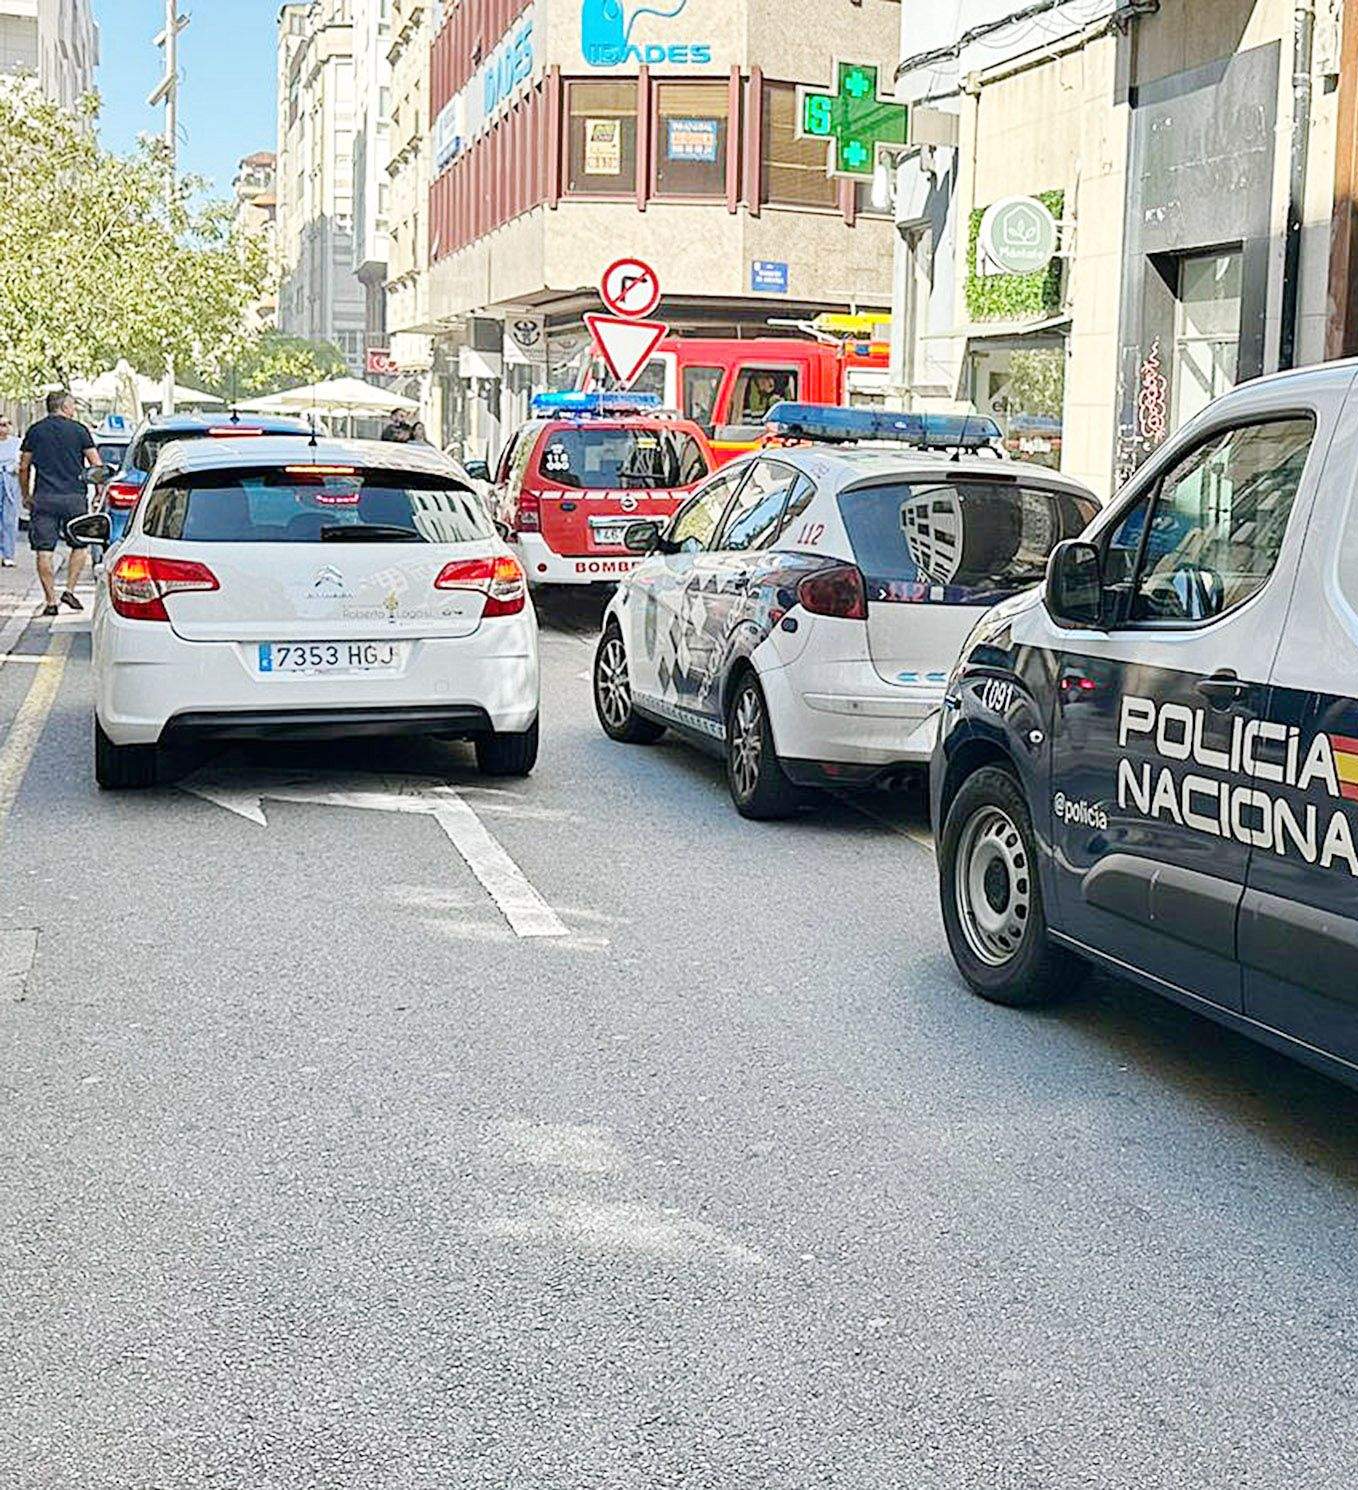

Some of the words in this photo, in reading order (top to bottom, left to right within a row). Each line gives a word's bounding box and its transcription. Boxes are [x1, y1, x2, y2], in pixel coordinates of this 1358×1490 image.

[797, 523, 825, 546] 112
[277, 645, 338, 667] 7353
[348, 645, 394, 664] HGJ
